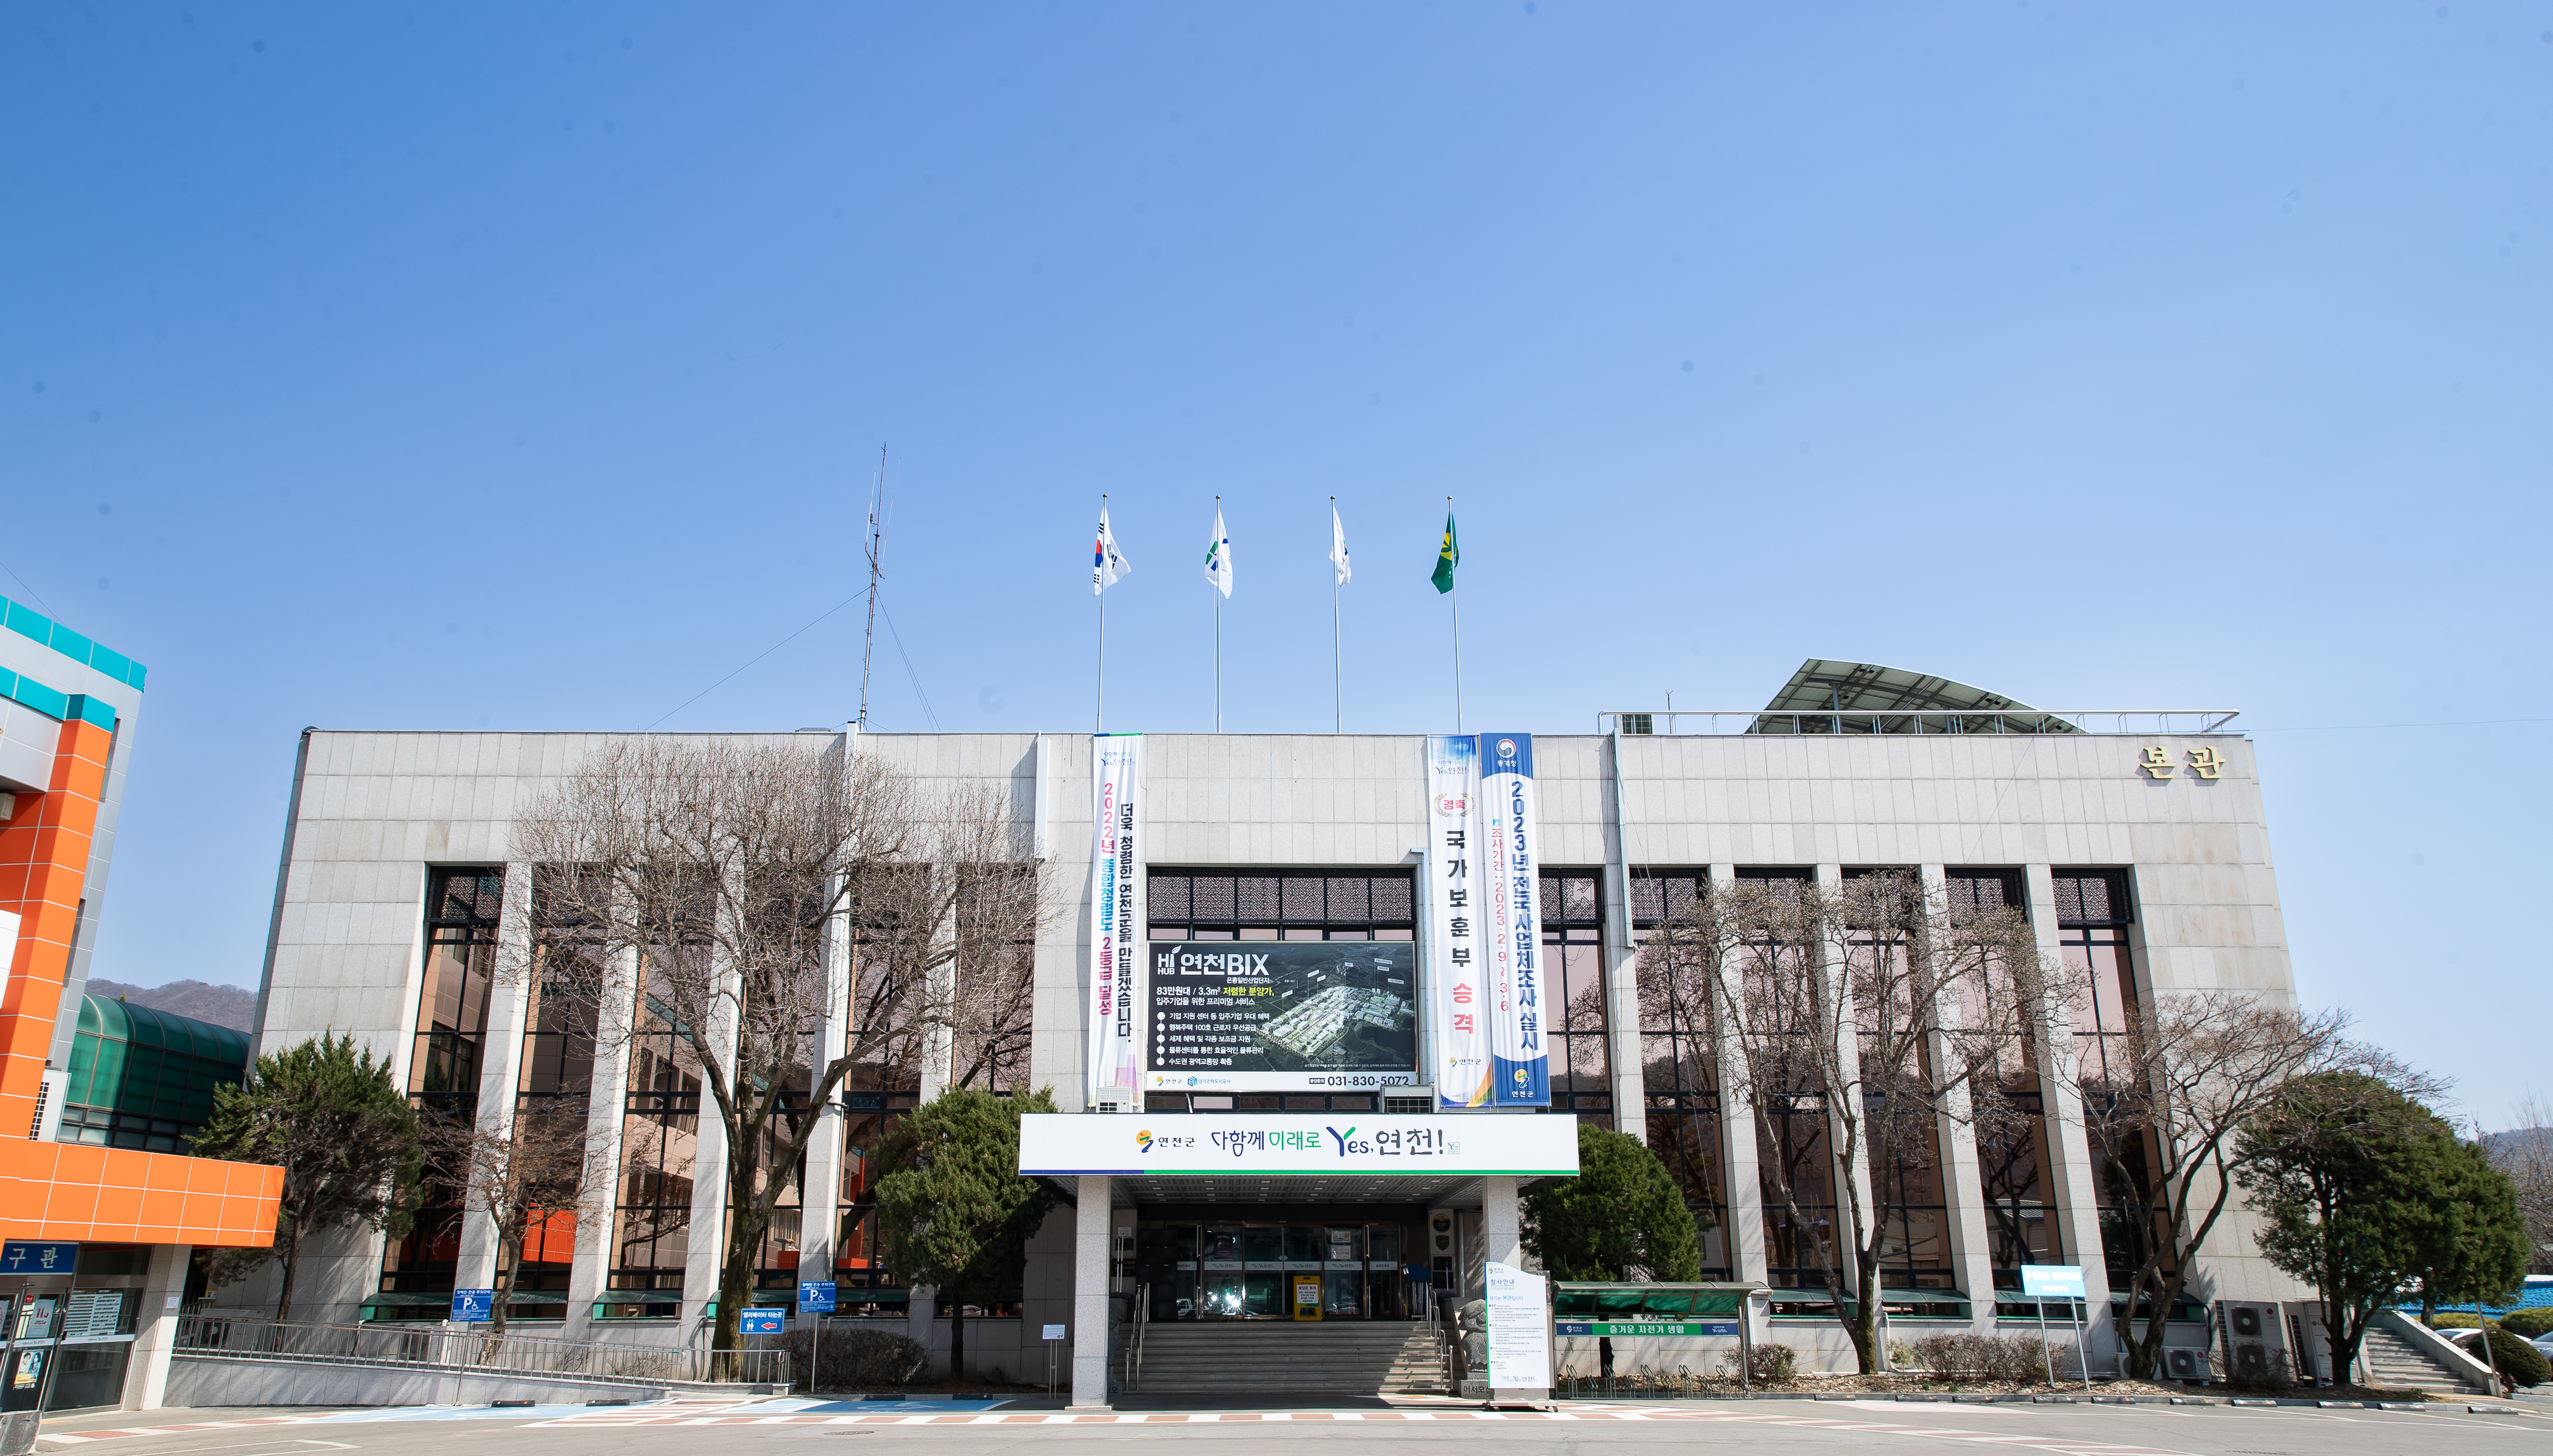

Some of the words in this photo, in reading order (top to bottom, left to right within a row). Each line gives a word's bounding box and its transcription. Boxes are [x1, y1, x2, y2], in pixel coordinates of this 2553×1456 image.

[2140, 746, 2226, 778] 본관
[1102, 783, 1115, 854] 2022년
[1121, 803, 1133, 831] 더욱
[1444, 800, 1466, 810] 경축
[1119, 836, 1133, 879] 청렴한
[1100, 858, 1115, 931] 종합청렴도
[1447, 830, 1471, 967] 국가보훈부
[1118, 884, 1133, 943] 연천군을
[1511, 781, 1529, 872] 2023년
[1520, 1012, 1538, 1051] 실시
[1099, 936, 1113, 980] 2등급
[1180, 954, 1269, 975] 연천BIX
[1098, 985, 1112, 1015] 달성
[1117, 947, 1133, 1043] 만들겠습니다.
[1156, 987, 1190, 995] 83만원대
[1223, 987, 1246, 996] 저렴한
[1248, 987, 1275, 996] 분양가,
[1156, 997, 1190, 1006] 입주기업을
[1191, 997, 1205, 1006] 위한
[1206, 997, 1233, 1006] 프리미엄
[1235, 997, 1256, 1006] 서비스
[1452, 983, 1474, 1034] 승격
[1328, 1076, 1409, 1086] 031-830-5072
[1158, 1137, 1195, 1147] 연천군
[1211, 1130, 1264, 1157] 다함께
[1269, 1131, 1321, 1150] 미래로
[9, 1247, 57, 1269] 구관
[463, 1297, 472, 1310] P
[810, 1290, 818, 1301] P
[1609, 1324, 1635, 1334] 즐거운
[1638, 1324, 1664, 1334] 자전거
[1667, 1324, 1684, 1334] 생활
